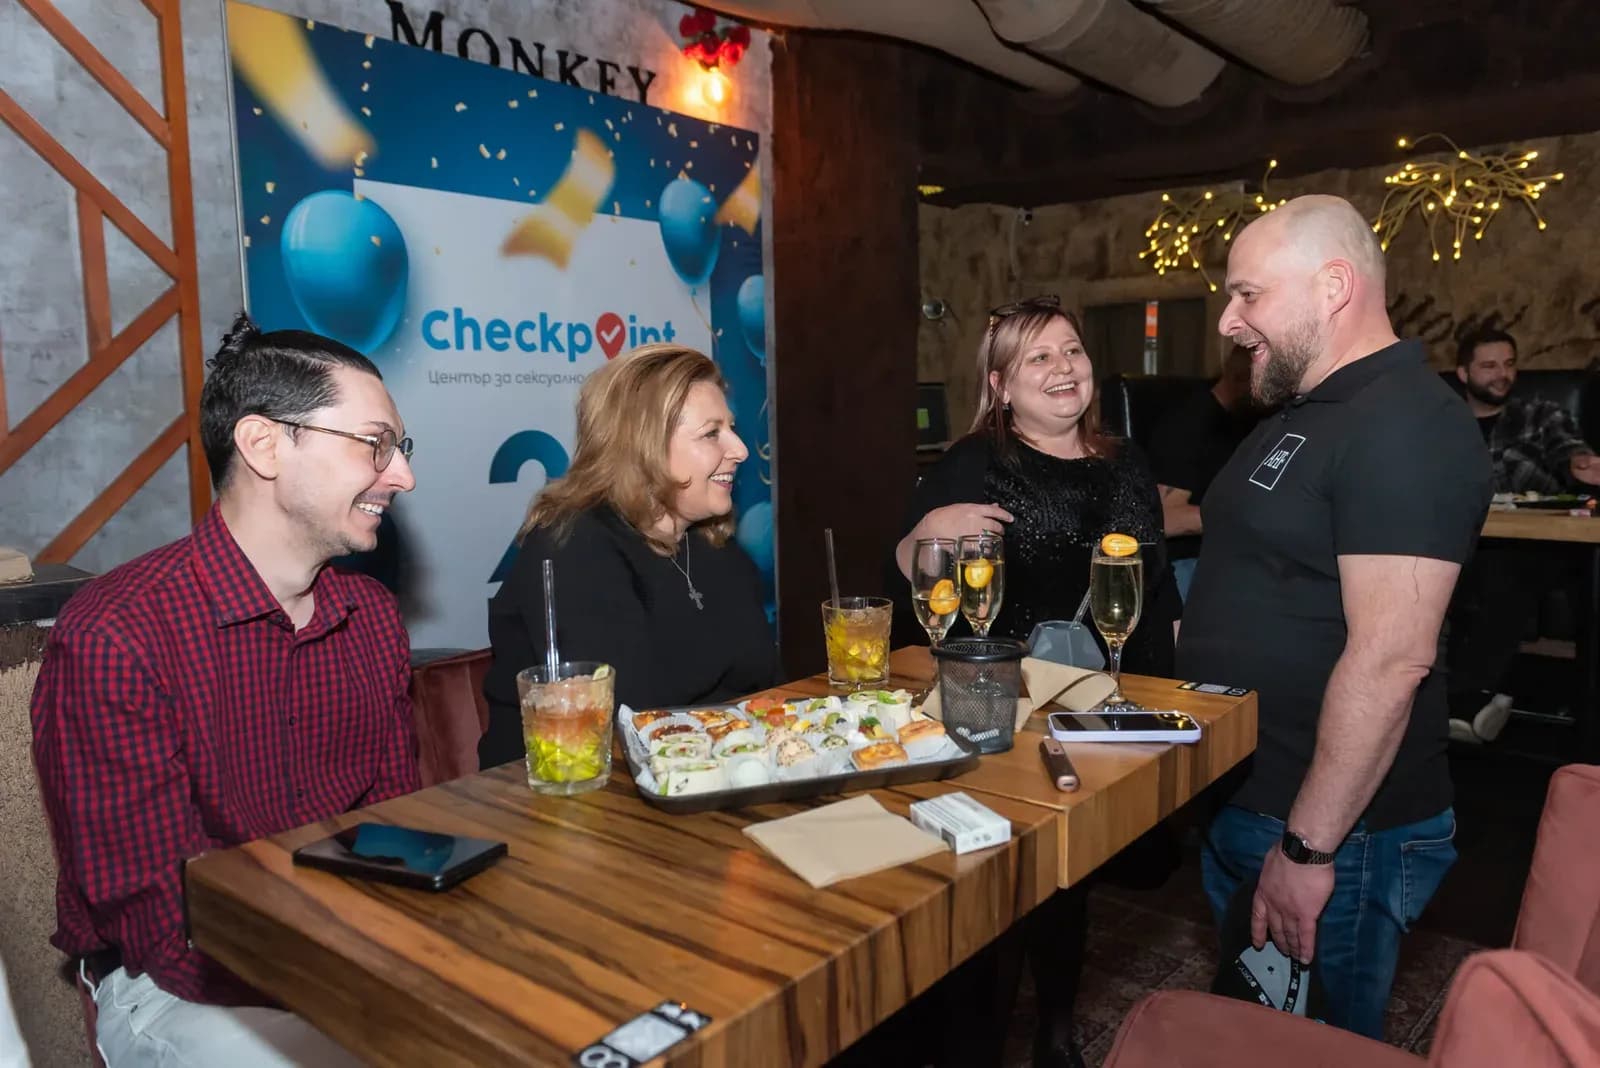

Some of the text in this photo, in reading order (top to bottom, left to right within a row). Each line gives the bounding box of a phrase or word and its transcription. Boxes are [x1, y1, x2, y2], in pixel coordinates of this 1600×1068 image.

[385, 0, 656, 105] MONKEY
[428, 370, 491, 387] Център
[495, 372, 512, 387] за
